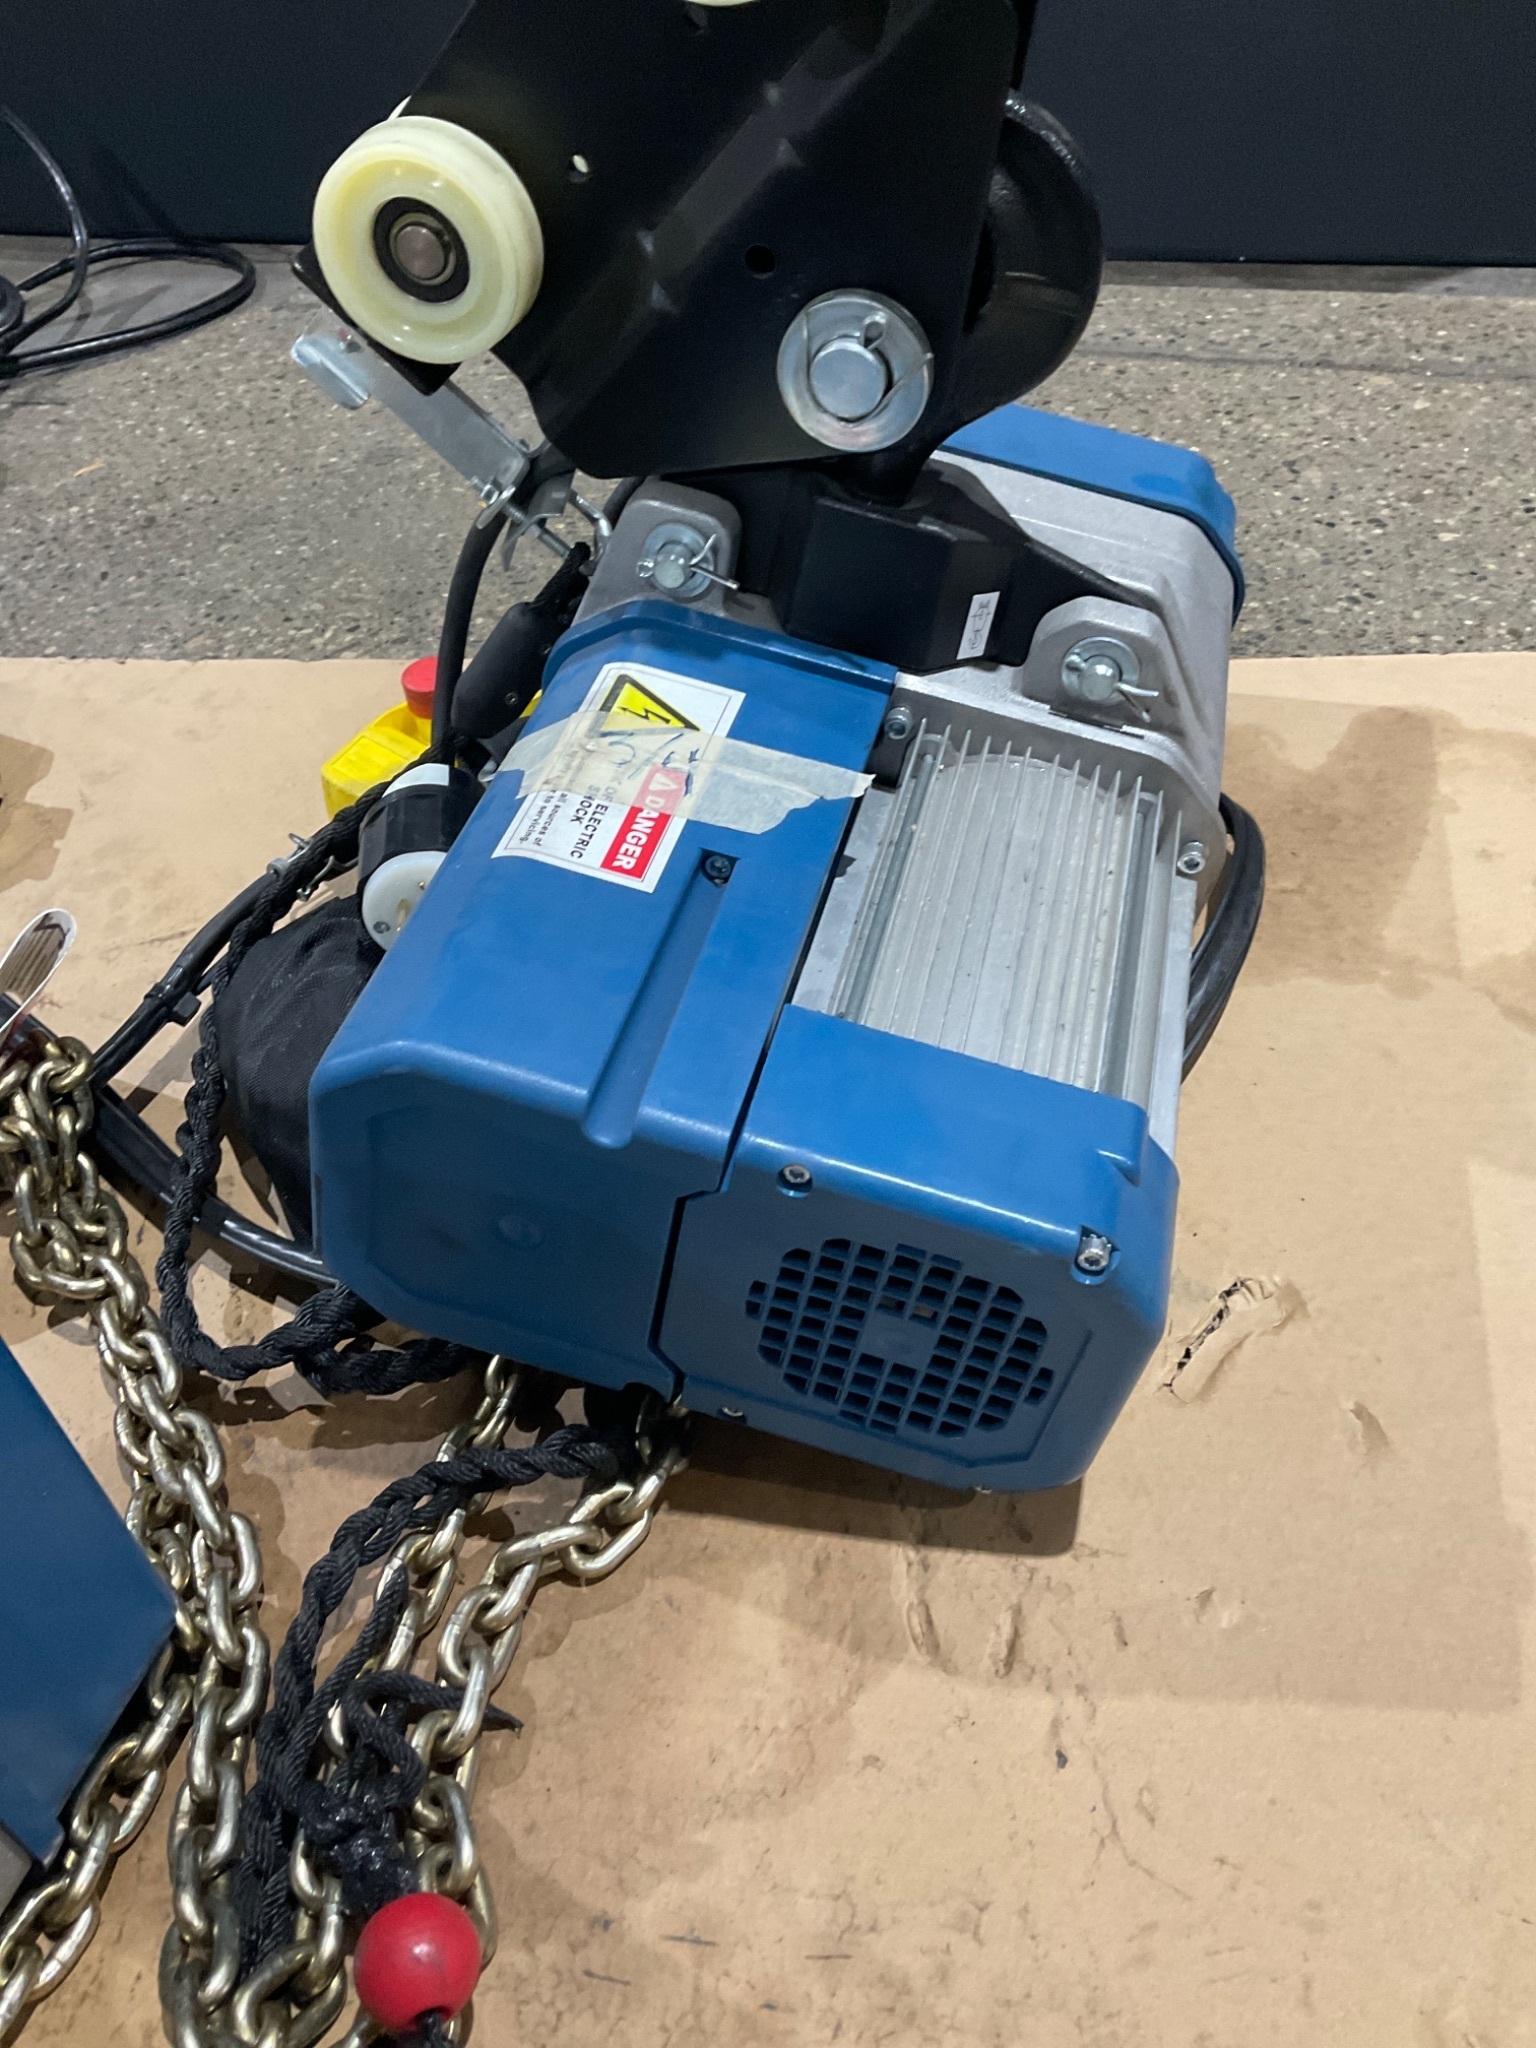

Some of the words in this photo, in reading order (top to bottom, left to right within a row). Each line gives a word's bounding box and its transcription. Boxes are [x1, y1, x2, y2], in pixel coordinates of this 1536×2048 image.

[543, 795, 554, 804] to
[570, 785, 601, 824] SHOCK
[539, 804, 561, 835] sources
[570, 803, 609, 859] ELECTRIC
[611, 795, 666, 872] DANGER
